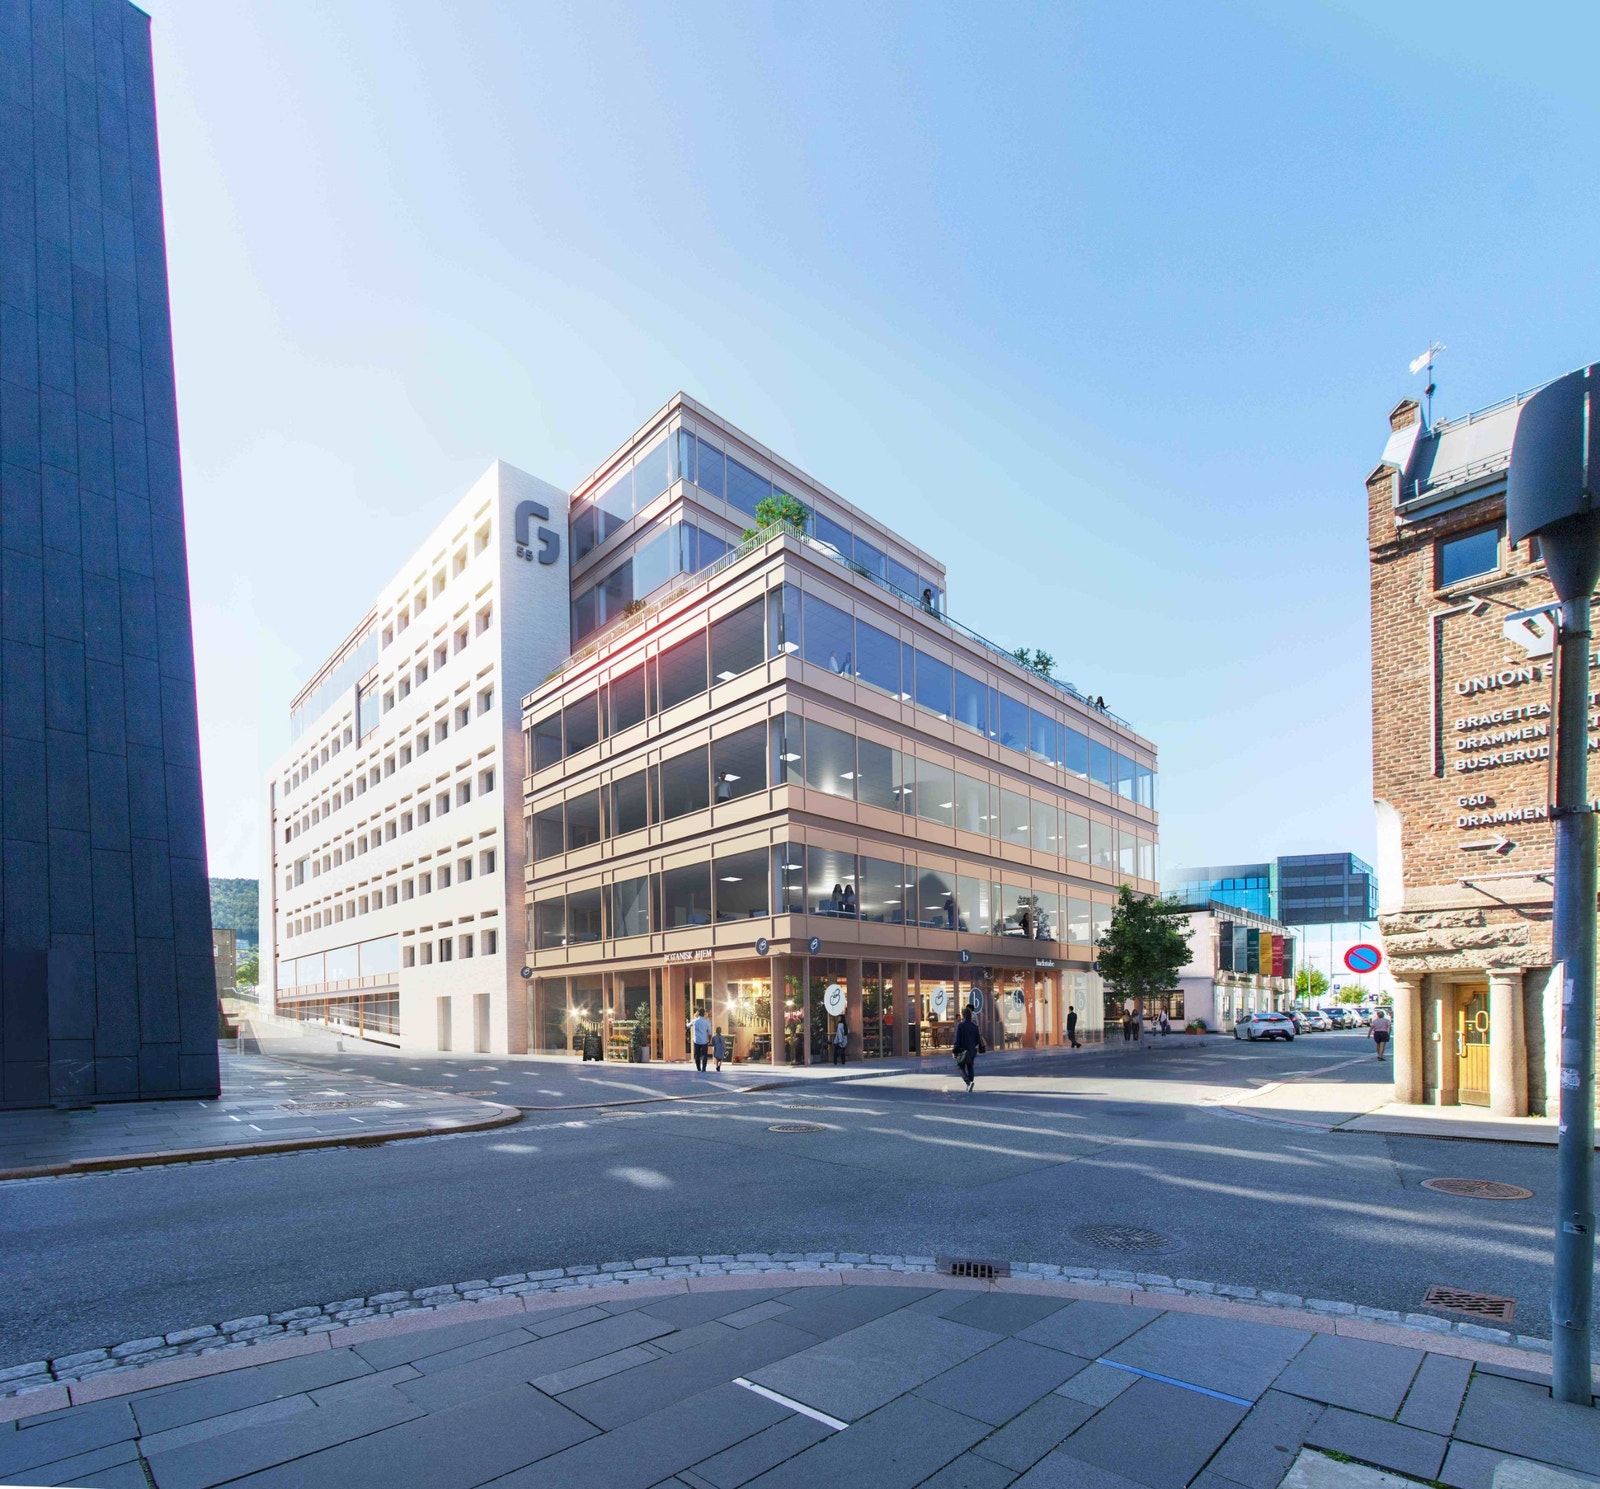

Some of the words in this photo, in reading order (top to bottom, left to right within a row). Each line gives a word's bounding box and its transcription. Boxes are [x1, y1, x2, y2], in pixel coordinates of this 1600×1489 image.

[1454, 667, 1534, 695] UNION
[1454, 702, 1551, 730] BRAGETEA
[1457, 793, 1487, 807] G60
[695, 949, 712, 961] HJEM
